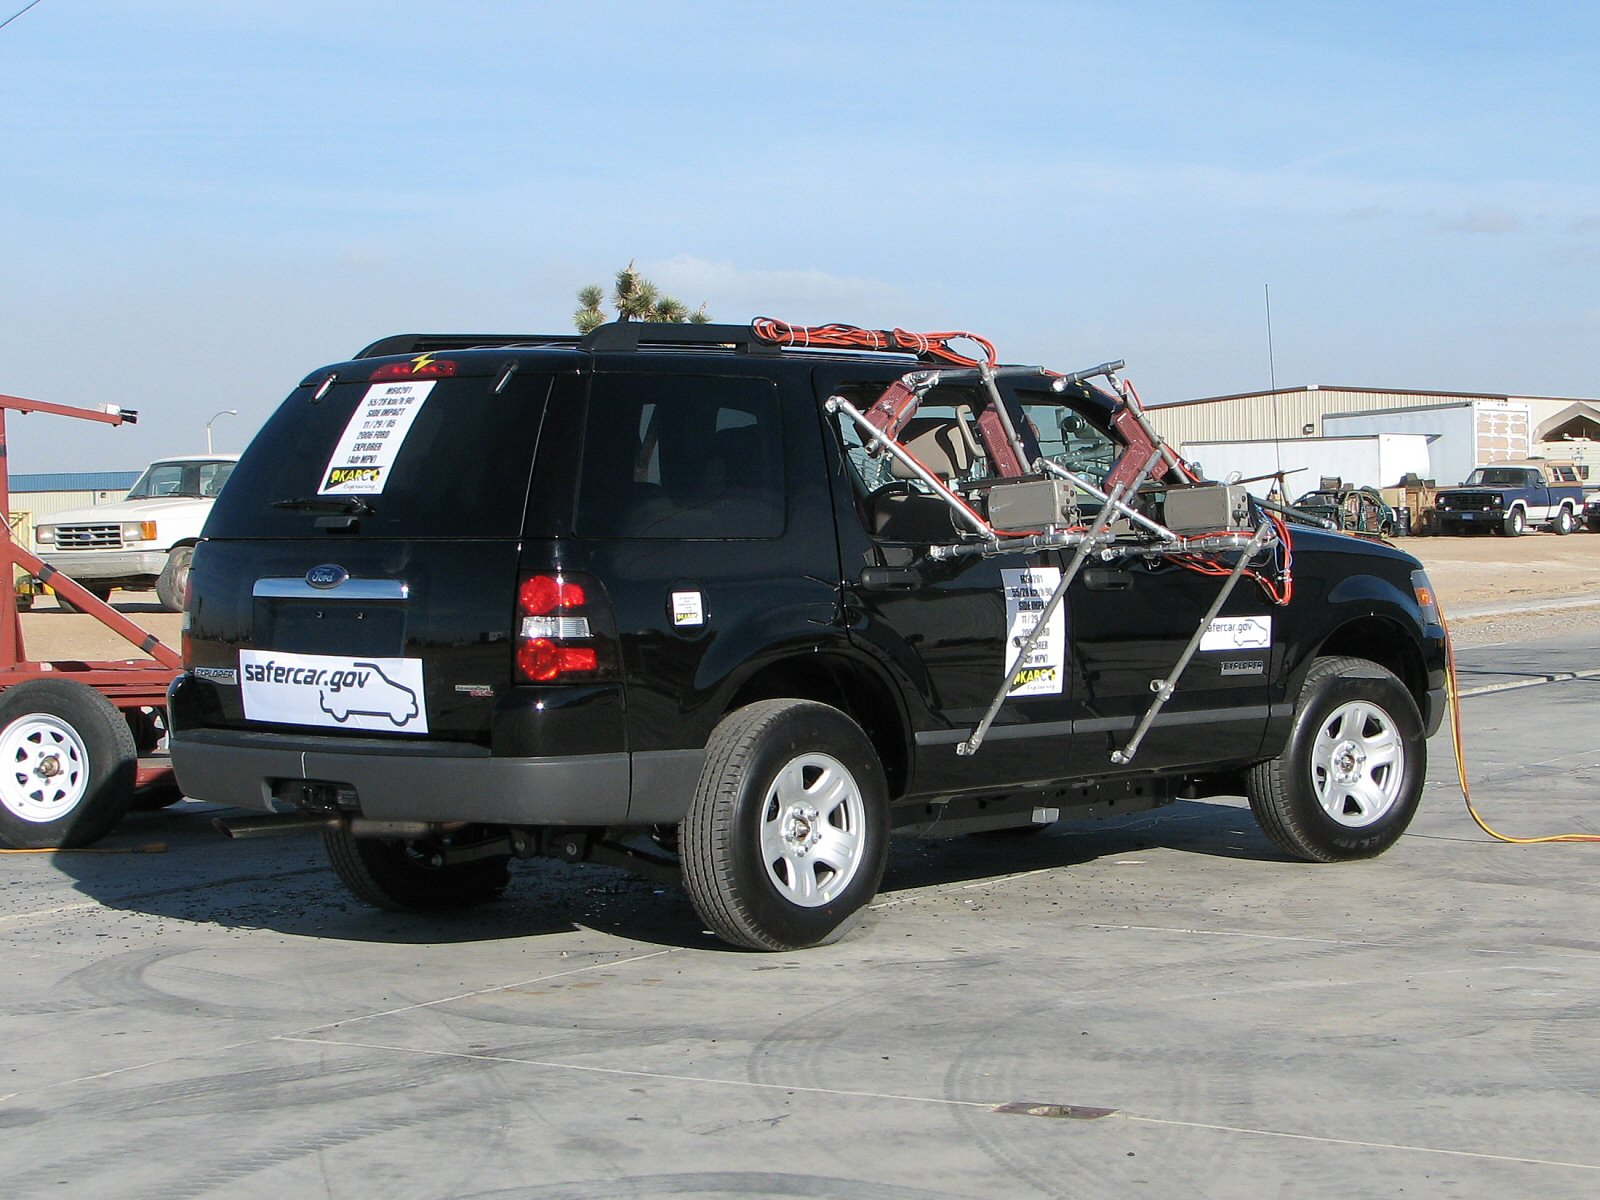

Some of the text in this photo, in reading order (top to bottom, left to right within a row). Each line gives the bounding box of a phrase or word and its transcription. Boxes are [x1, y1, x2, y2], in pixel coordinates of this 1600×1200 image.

[366, 408, 406, 417] SIDE IMPACT
[356, 430, 391, 440] 2006 FORD
[352, 443, 382, 452] EXPLORER
[311, 569, 336, 582] Ford
[1223, 661, 1262, 670] EXPLORER
[196, 668, 235, 679] EXPLORER
[245, 660, 371, 692] safercar.gov
